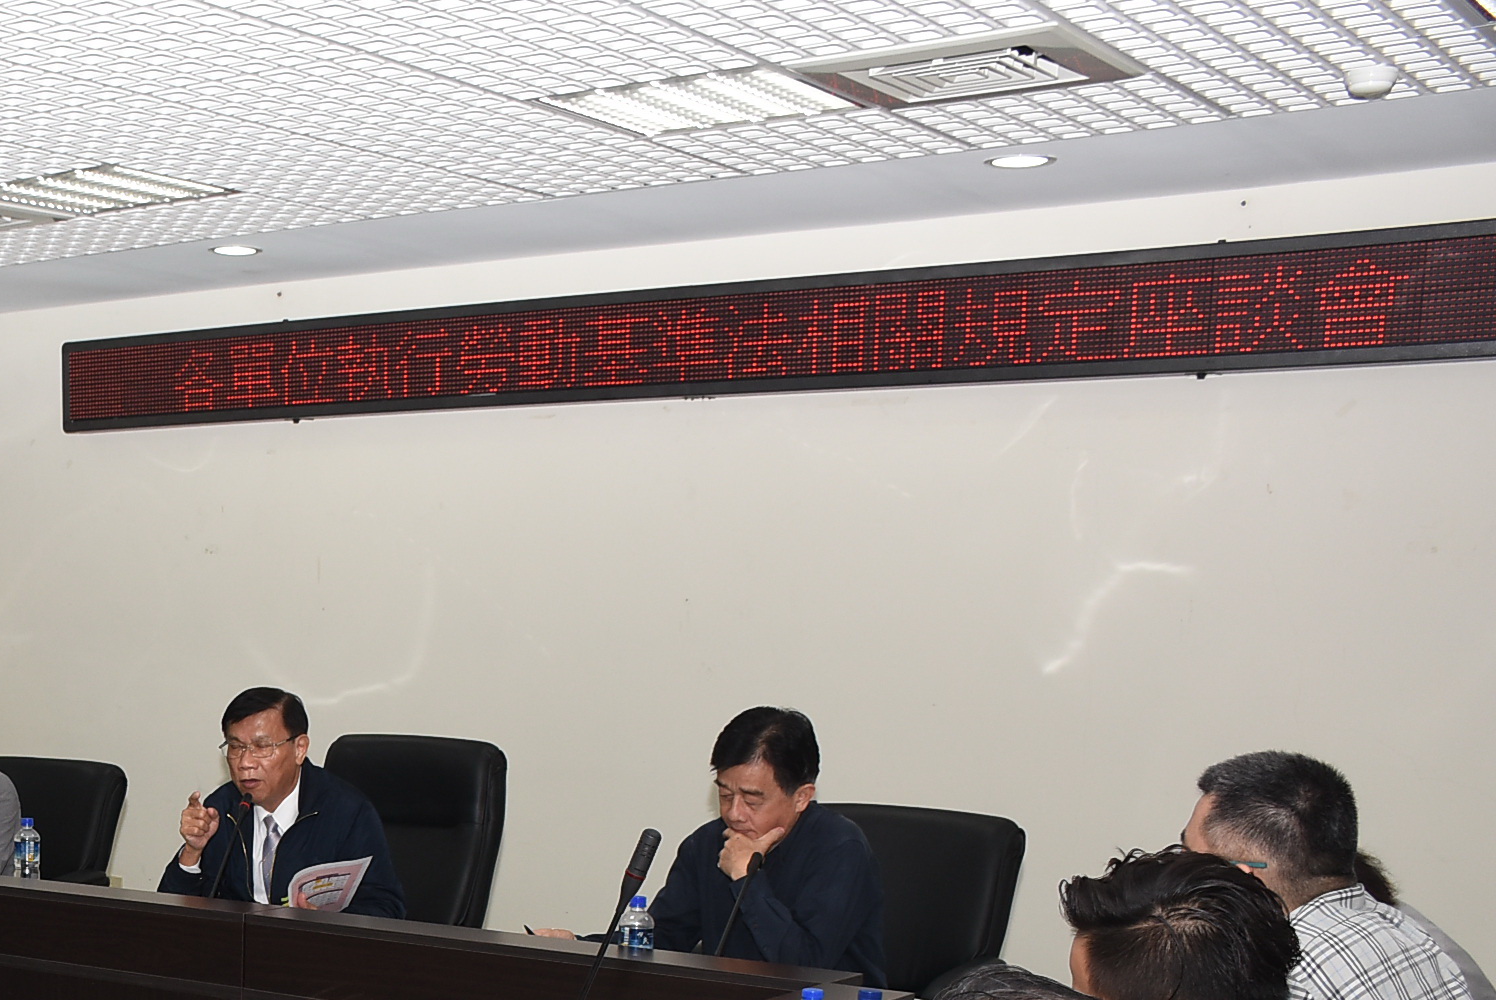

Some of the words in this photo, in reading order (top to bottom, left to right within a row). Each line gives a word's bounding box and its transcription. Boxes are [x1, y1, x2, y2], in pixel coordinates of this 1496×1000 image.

[173, 258, 1411, 413] 各單位執行勞動基準法相關規定座談會
